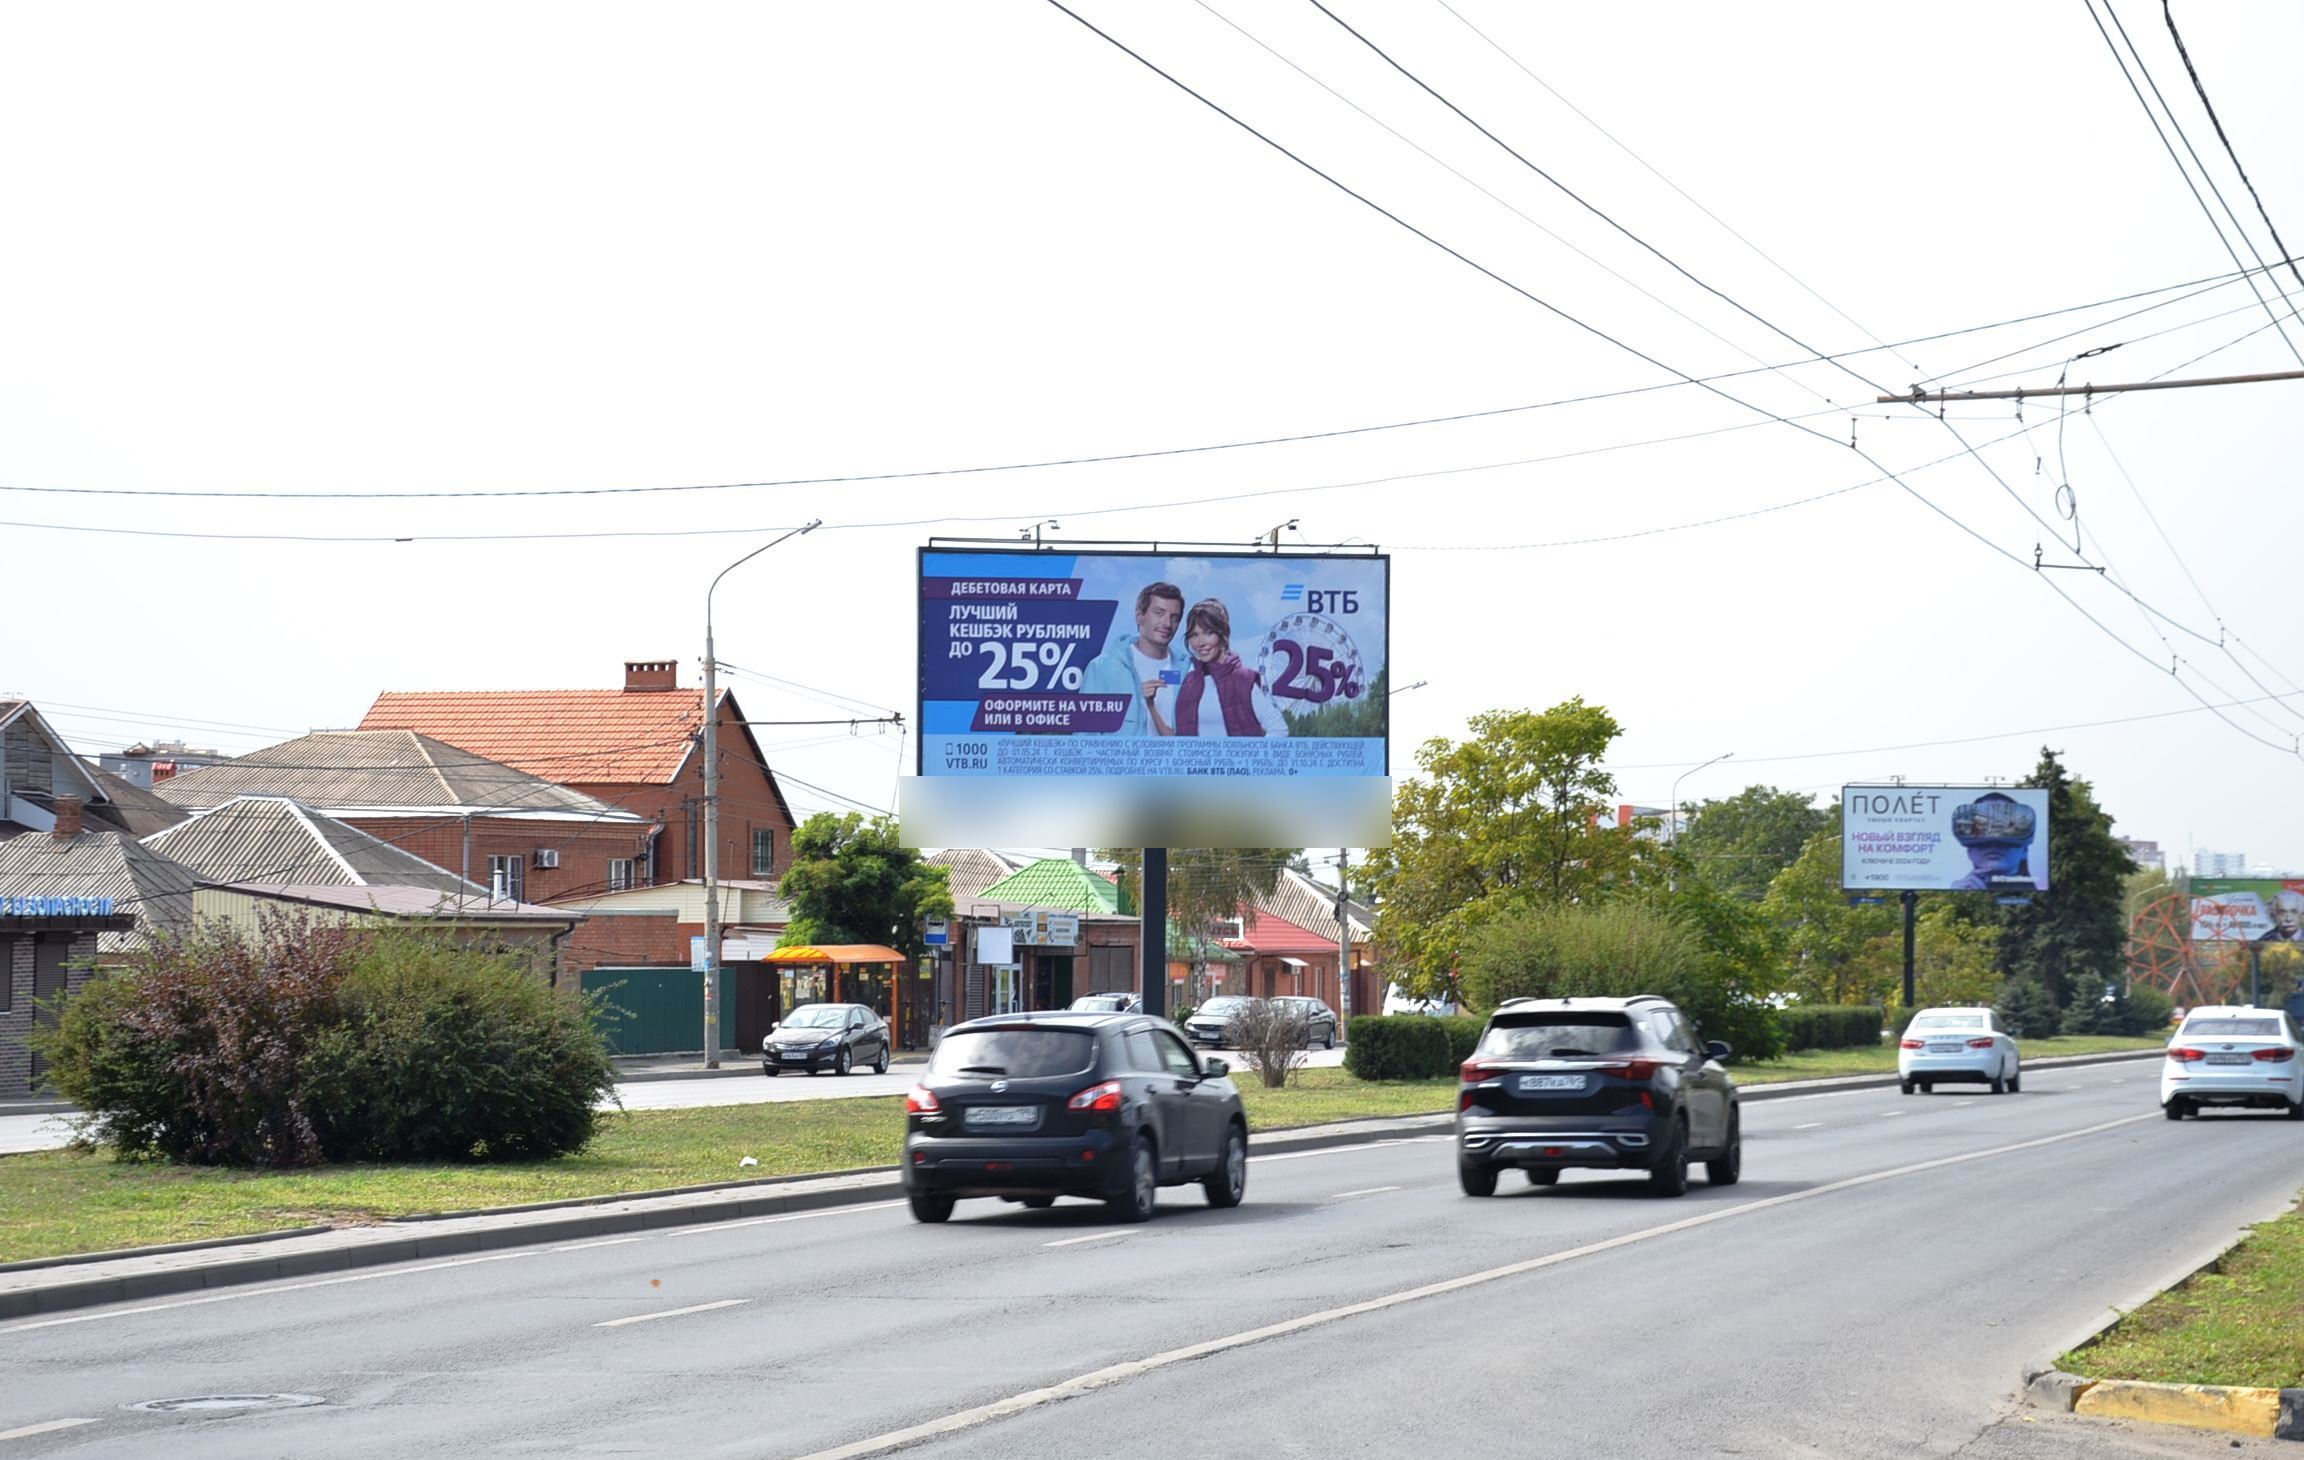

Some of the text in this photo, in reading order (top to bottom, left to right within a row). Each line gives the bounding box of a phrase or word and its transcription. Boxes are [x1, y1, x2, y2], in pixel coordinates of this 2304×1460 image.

[951, 582, 1071, 596] ДЕБЕТОВАЯ КАРТА
[1307, 590, 1359, 614] ВТБ
[949, 602, 1018, 620] ЛУЧШИЙ
[949, 623, 1090, 639] КЕШБЭК РУБЛЯМИ
[948, 641, 1084, 691] ДО 25%
[1272, 639, 1360, 704] 25%
[984, 699, 1123, 713] ОФОРМИТЕ НА VTB.RU
[984, 713, 1070, 726] ИЛИ В ОФИСЕ
[956, 743, 988, 755] 1000
[946, 758, 988, 769] VTB.RU
[1852, 831, 1941, 843] НОВЫЙ ВЗГЛЯД
[1858, 843, 1935, 853] НА КОМФОРТ
[13, 895, 113, 916] БЕЗОПАСНОСТИ
